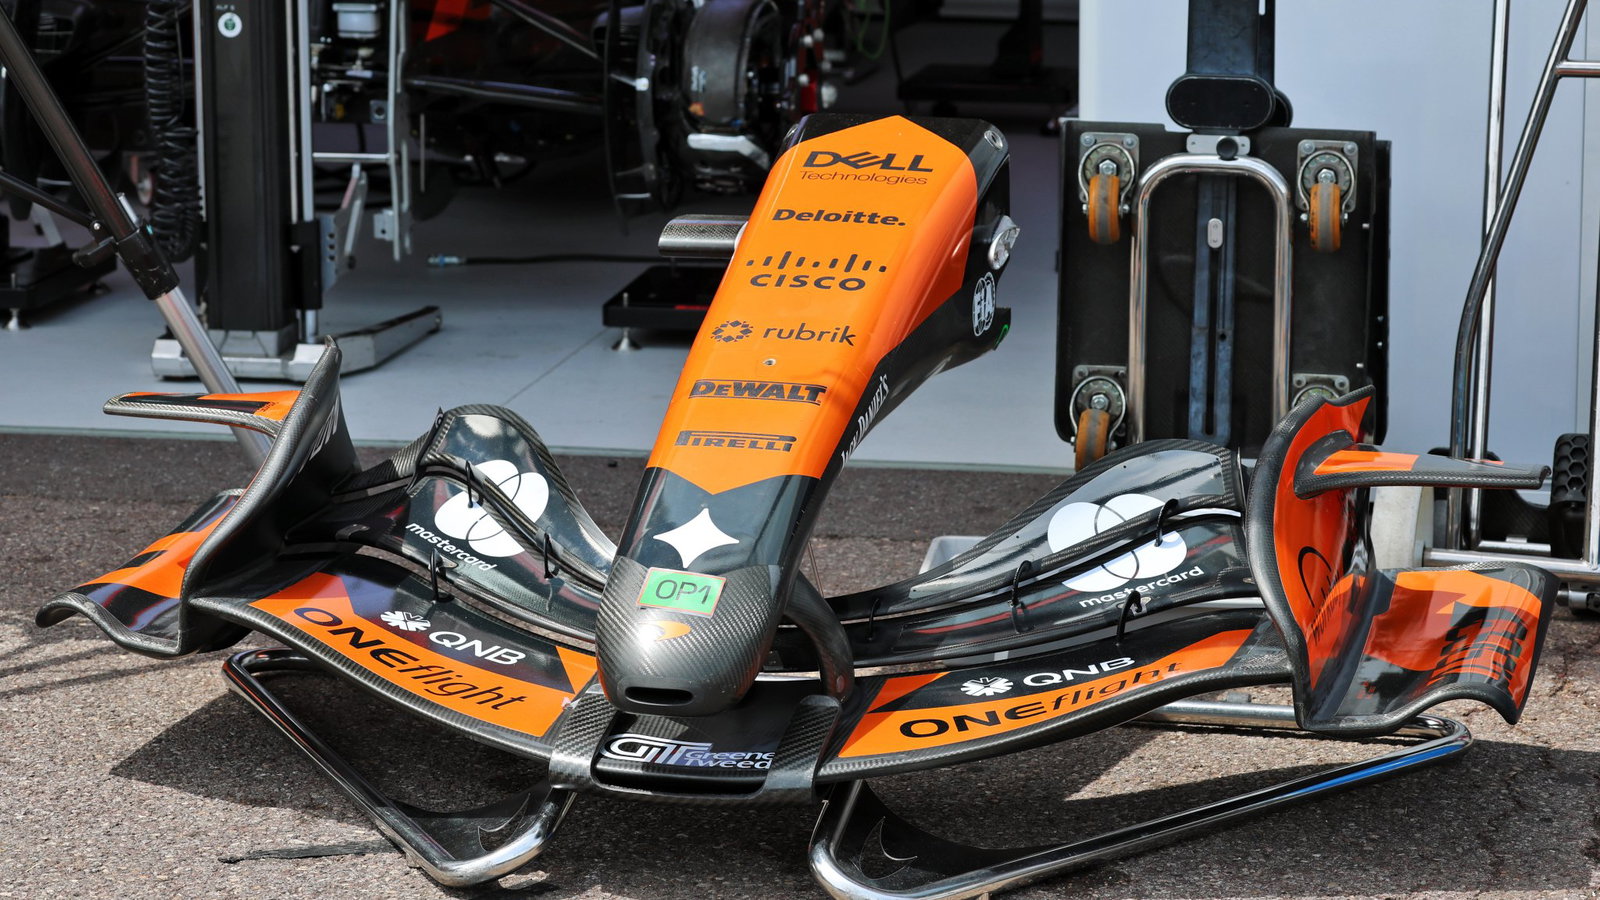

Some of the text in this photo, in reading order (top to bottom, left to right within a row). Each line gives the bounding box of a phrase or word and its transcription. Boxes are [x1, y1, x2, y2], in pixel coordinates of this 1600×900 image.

[803, 151, 933, 173] DELL
[800, 170, 927, 185] Technologies
[772, 208, 906, 226] Deloitte.
[763, 323, 857, 347] rubrik
[675, 430, 797, 452] PIRELLI
[405, 522, 498, 571] mastercard
[655, 579, 712, 605] OP1
[1079, 565, 1205, 608] mastercard
[293, 607, 528, 711] ONEflight
[428, 630, 527, 666] QNB
[1022, 656, 1136, 688] QNB
[685, 751, 776, 761] Greene
[685, 758, 774, 769] Tweed
